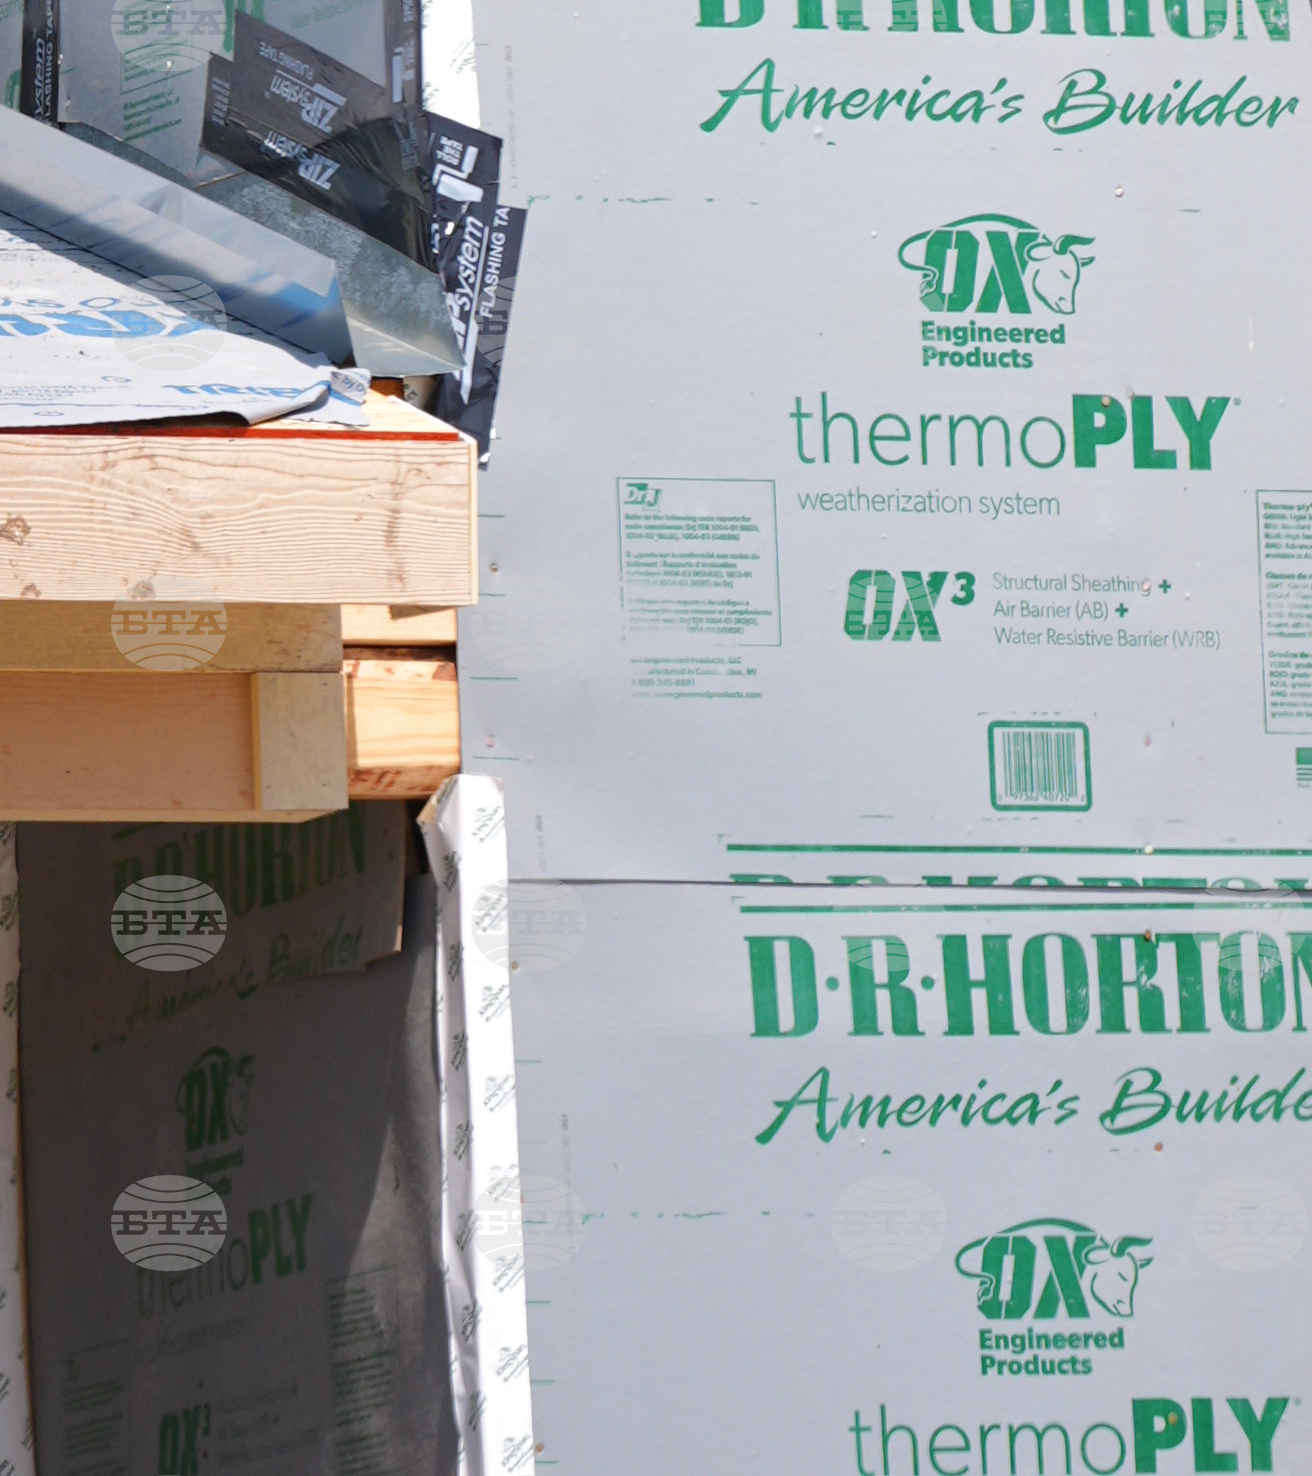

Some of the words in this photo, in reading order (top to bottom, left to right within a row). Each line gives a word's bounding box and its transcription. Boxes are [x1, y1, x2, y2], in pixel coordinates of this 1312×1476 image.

[701, 59, 1023, 133] America's
[1043, 70, 1298, 136] Builder
[911, 231, 1041, 315] OX
[791, 393, 1229, 471] thermoPLY
[756, 1068, 1078, 1146] America's
[980, 1328, 1124, 1356] Engineered
